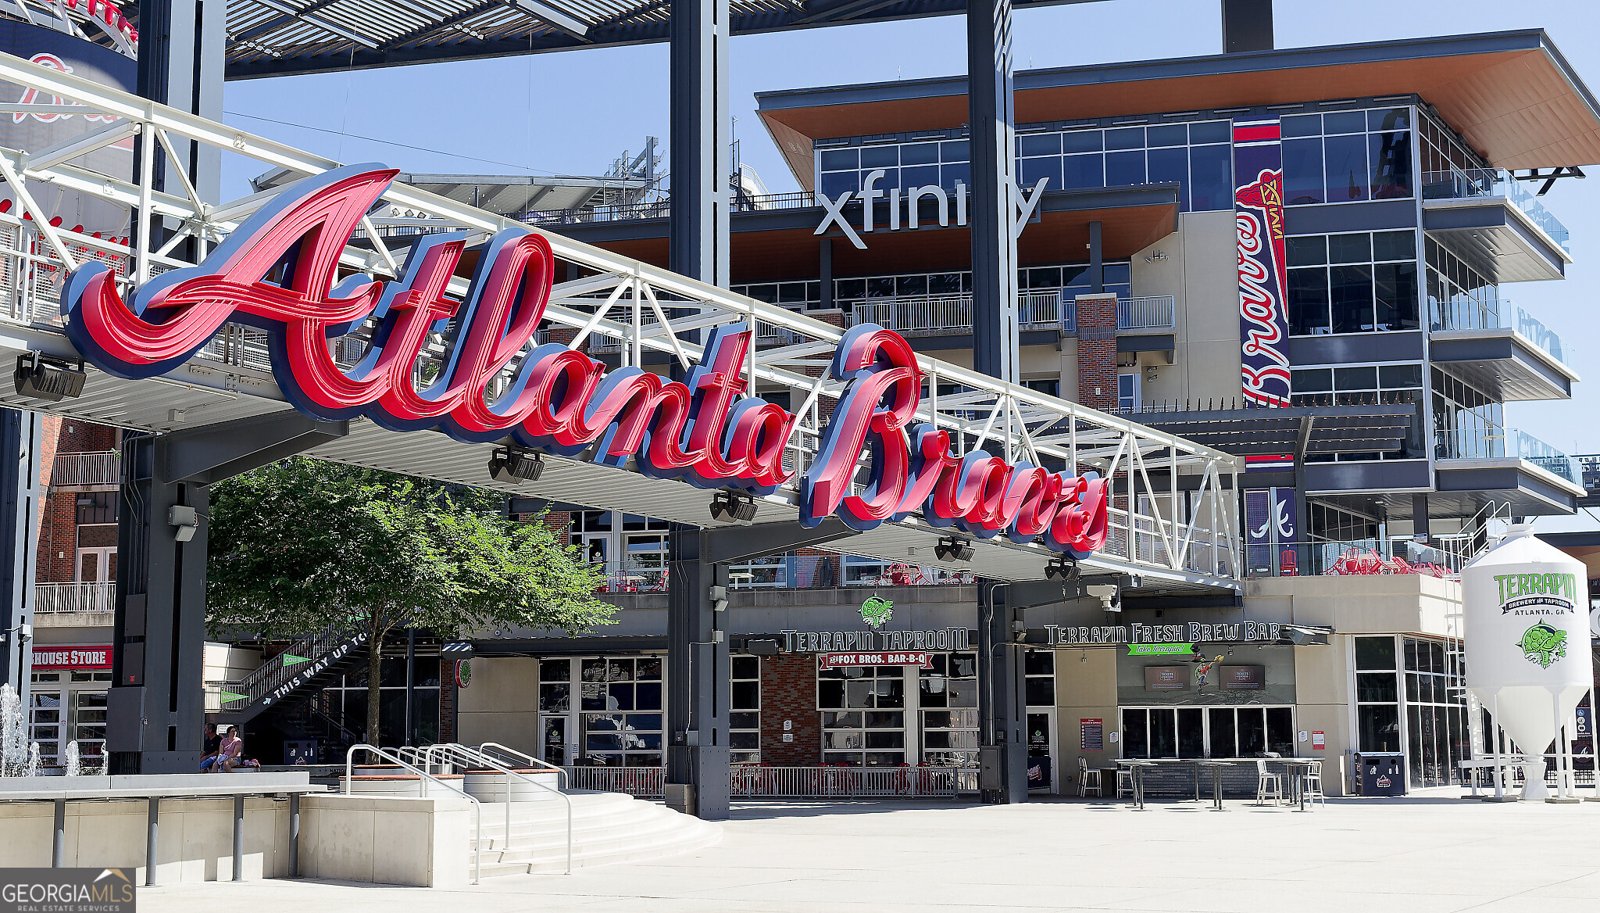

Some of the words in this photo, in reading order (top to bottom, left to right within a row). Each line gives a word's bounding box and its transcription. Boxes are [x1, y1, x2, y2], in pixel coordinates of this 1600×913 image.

[813, 169, 1050, 249] xfiniy
[62, 162, 797, 495] Atlanta
[799, 323, 1109, 560] Braves
[1493, 573, 1577, 606] TERRAPIN
[1508, 599, 1536, 608] BREWERY
[780, 629, 875, 653] TERRAPIN
[878, 626, 970, 651] TAPROOM
[1043, 624, 1127, 645] TERRAPIN
[1130, 622, 1184, 644] FRESH
[1187, 621, 1240, 643] BREW
[1243, 620, 1281, 642] BAR
[70, 650, 107, 665] STORE
[838, 655, 856, 664] FOX
[858, 654, 885, 665] BROS.
[887, 653, 926, 664] BAR-B-Q
[273, 676, 301, 700] THIS
[302, 656, 330, 680] WAY
[332, 643, 348, 661] UP
